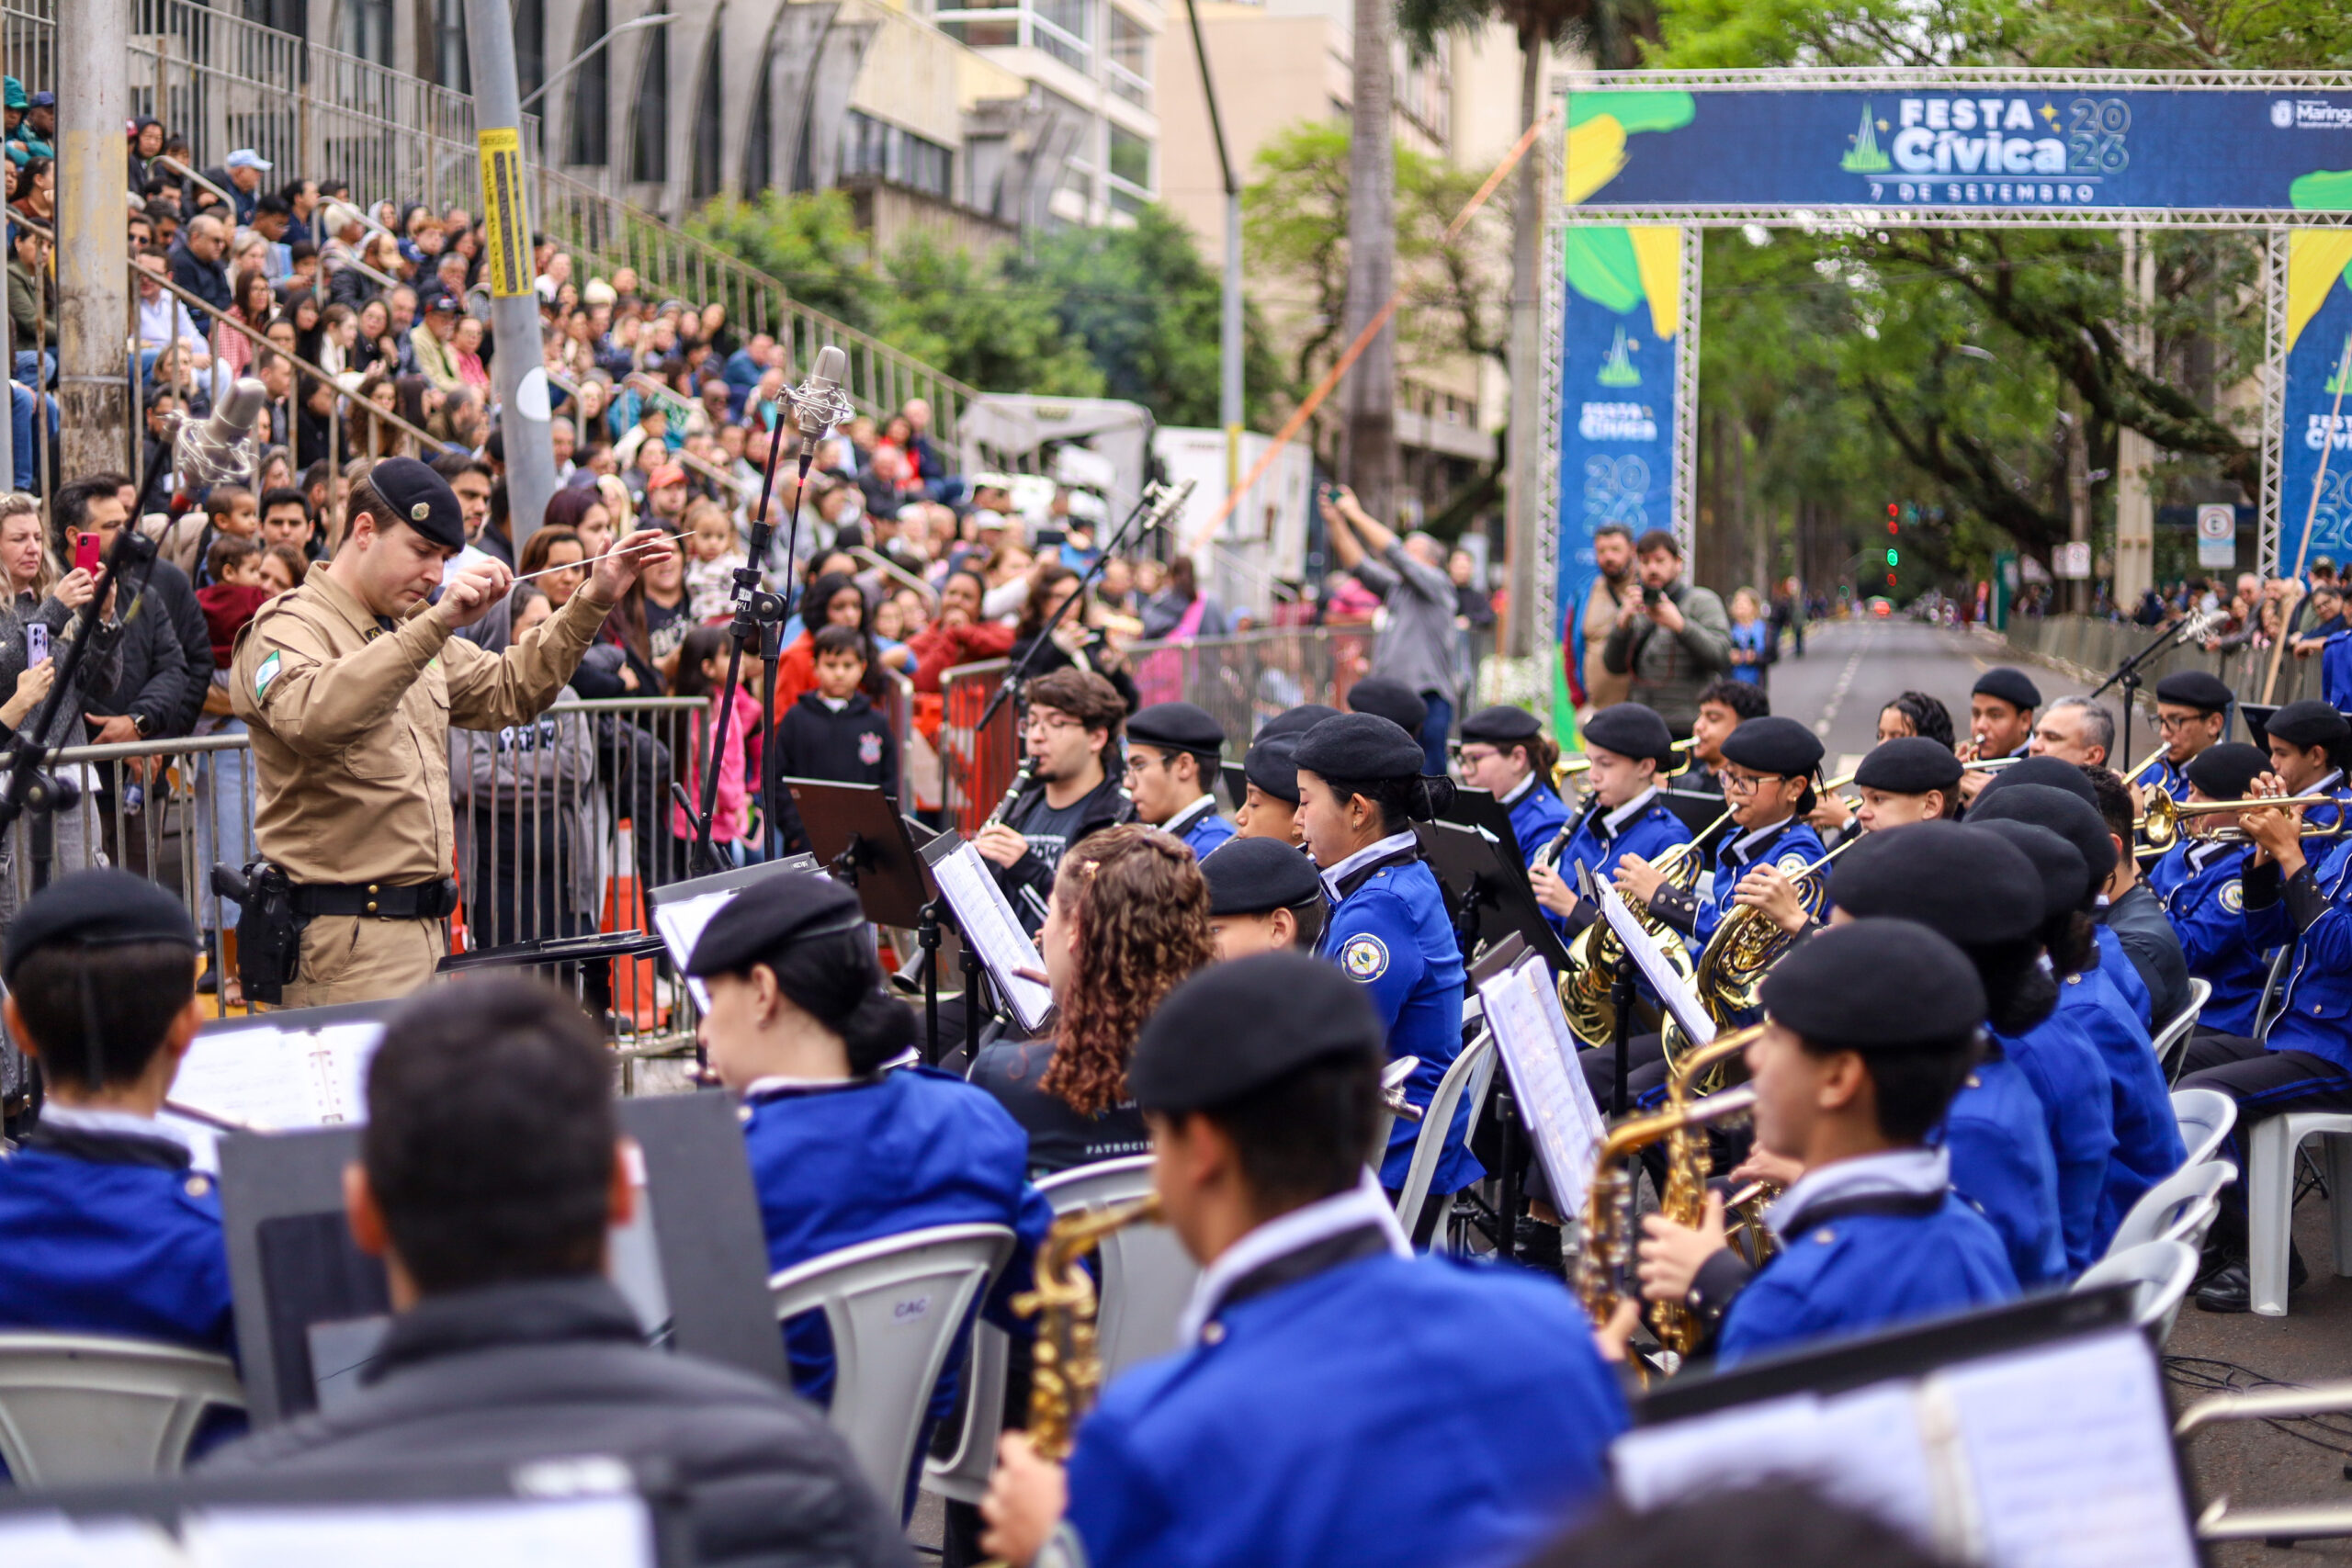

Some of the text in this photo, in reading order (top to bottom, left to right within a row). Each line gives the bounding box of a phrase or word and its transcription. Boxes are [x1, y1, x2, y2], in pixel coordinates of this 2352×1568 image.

[1899, 98, 2034, 130] FESTA
[2068, 97, 2132, 136] 20
[2296, 105, 2352, 123] Maring
[1893, 126, 2067, 175] Cívica
[2067, 133, 2130, 175] 26
[1870, 183, 2095, 203] 7 DE SETEMBRO
